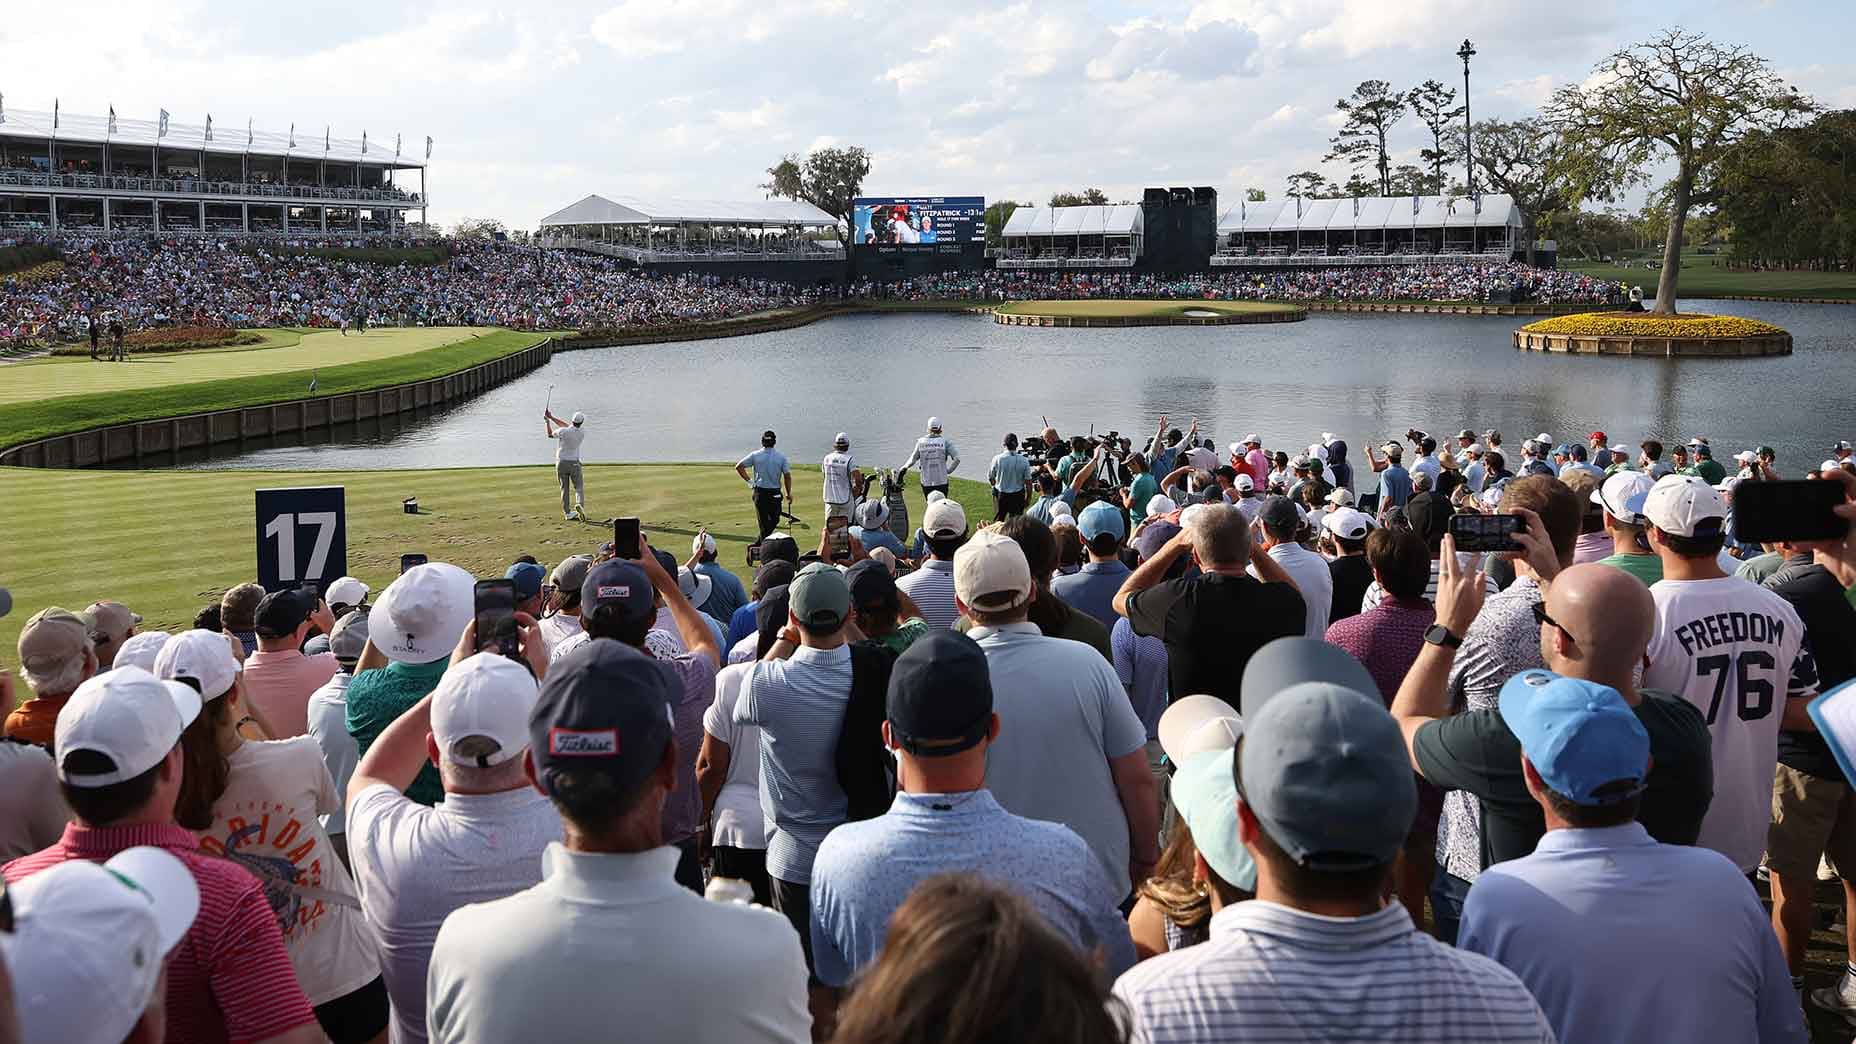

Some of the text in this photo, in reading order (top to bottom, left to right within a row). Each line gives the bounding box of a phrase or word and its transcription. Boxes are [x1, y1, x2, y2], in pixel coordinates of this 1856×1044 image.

[266, 511, 336, 581] 17
[600, 587, 627, 597] Titleist
[1674, 612, 1785, 656] FREEDOM
[1696, 650, 1775, 725] 76
[558, 735, 612, 753] Titleist
